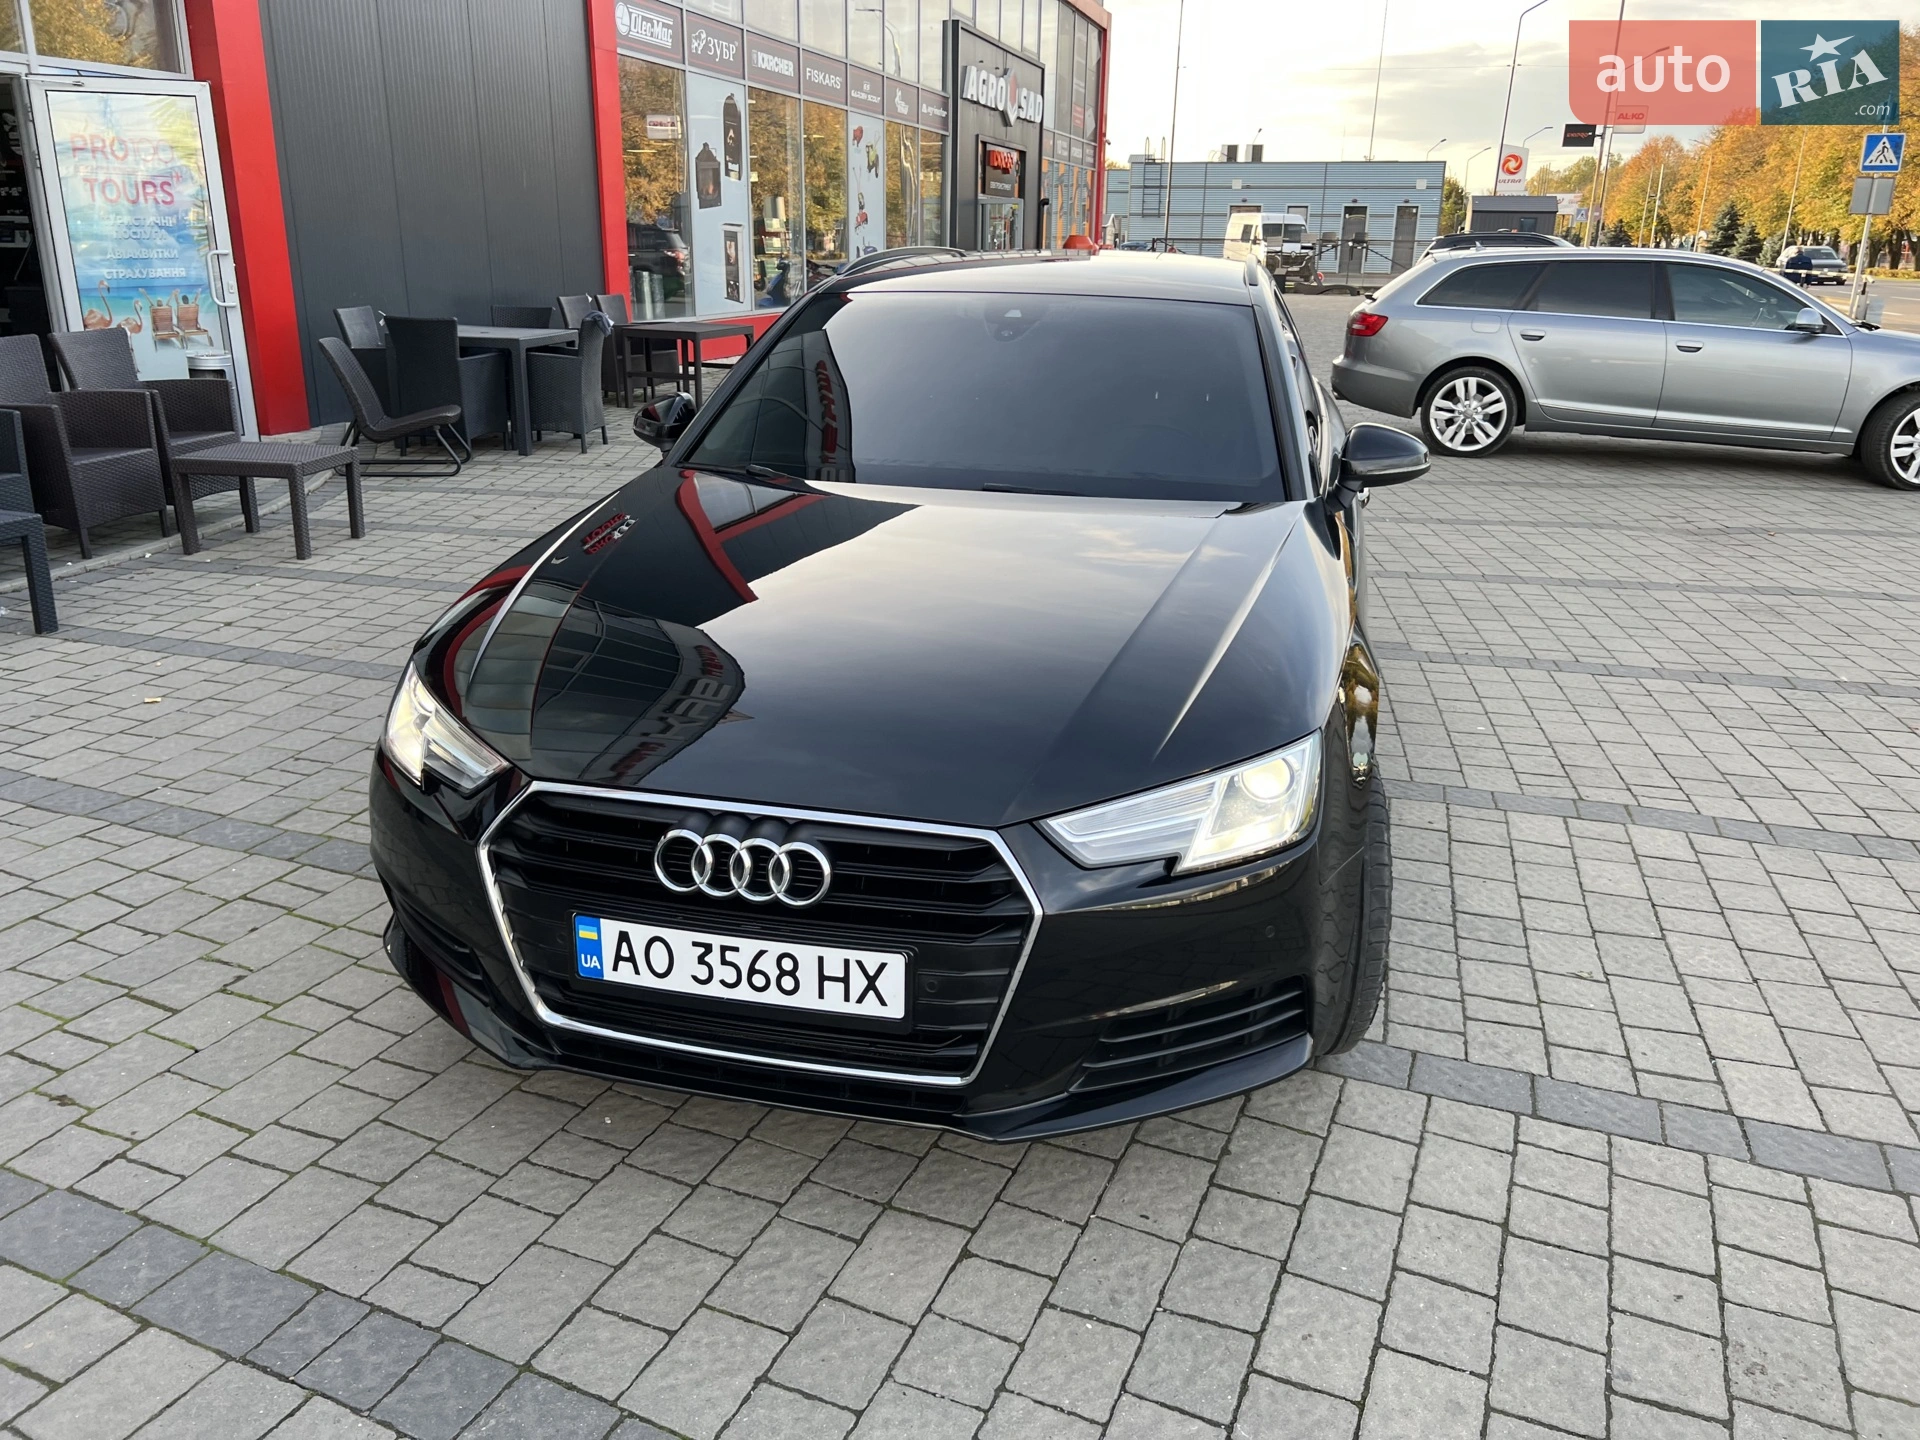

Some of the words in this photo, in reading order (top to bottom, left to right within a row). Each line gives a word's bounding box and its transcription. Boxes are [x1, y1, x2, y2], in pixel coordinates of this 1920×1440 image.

[707, 37, 736, 62] ЗУБР
[806, 67, 842, 89] FISKARS
[963, 66, 1006, 111] AGRO
[1018, 88, 1043, 124] SAD
[82, 177, 175, 206] TOURS
[106, 248, 179, 260] АВІАКВИТКИ
[103, 267, 187, 281] СТРАХУВАННЯ
[581, 953, 601, 970] UA
[611, 930, 675, 980] AO
[690, 941, 801, 997] 3568
[817, 955, 889, 1007] HX
